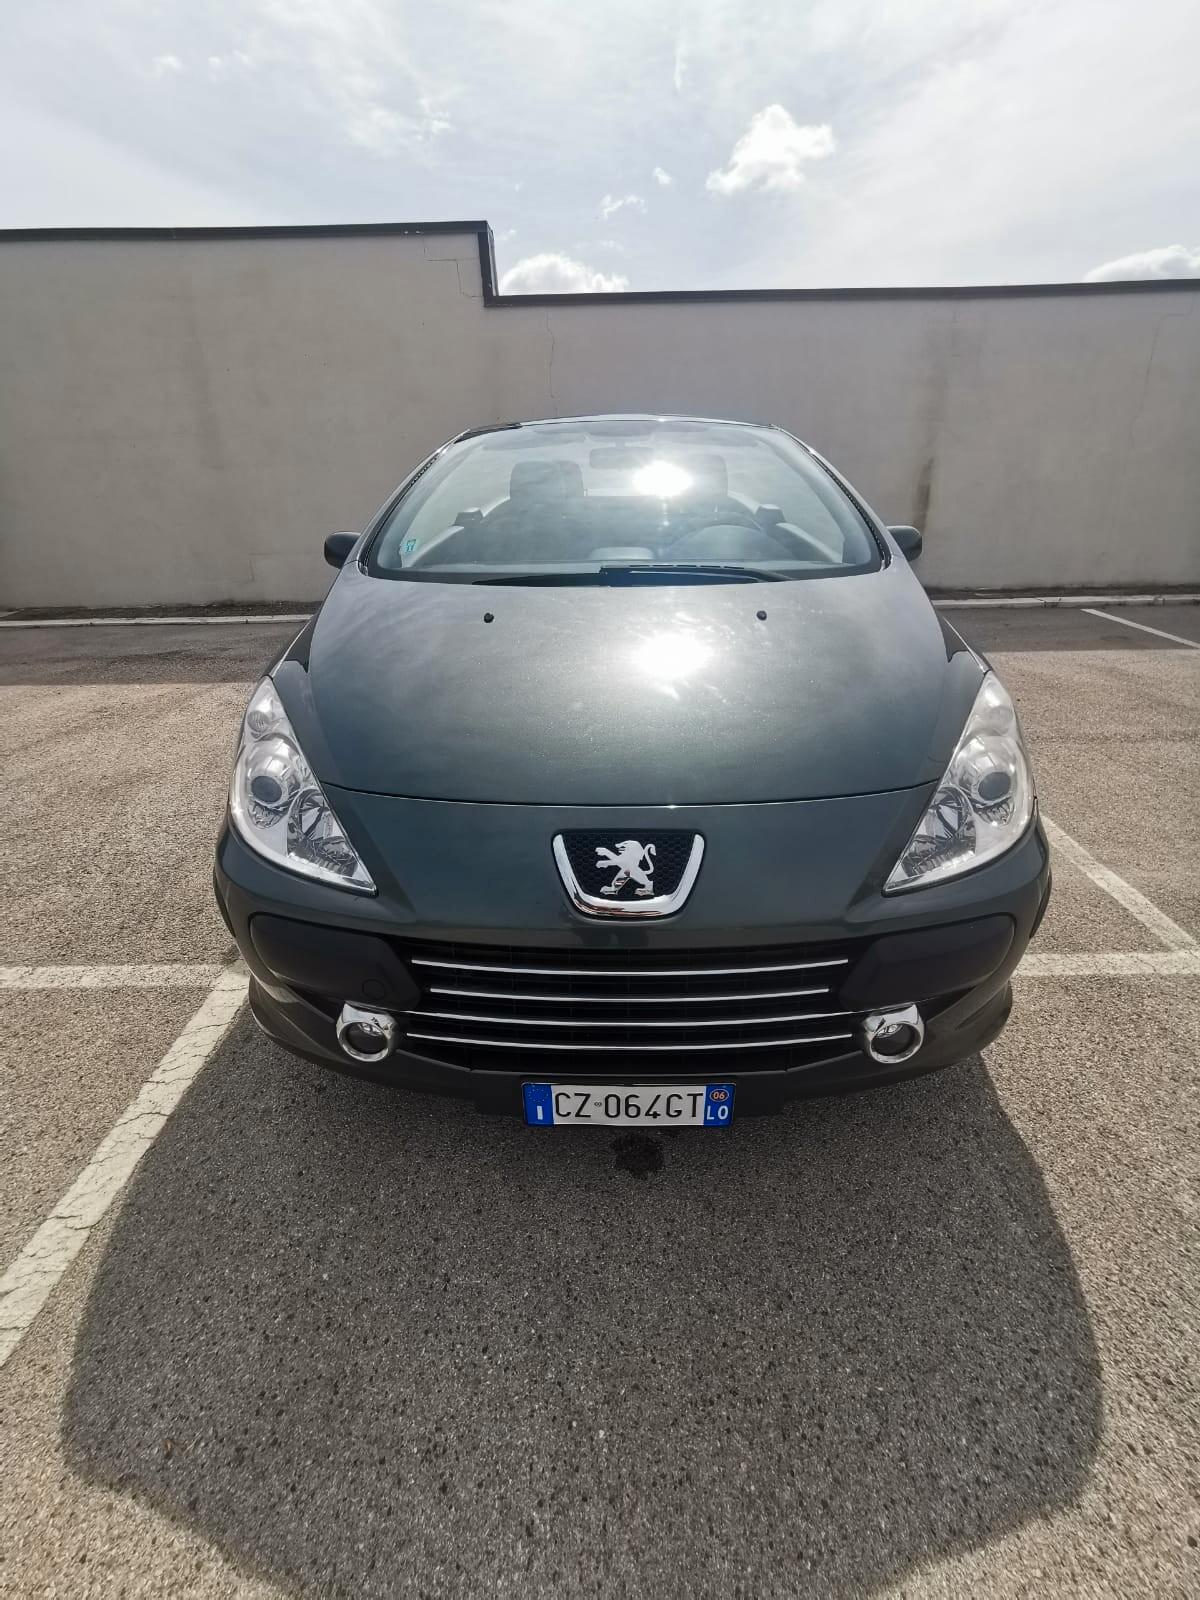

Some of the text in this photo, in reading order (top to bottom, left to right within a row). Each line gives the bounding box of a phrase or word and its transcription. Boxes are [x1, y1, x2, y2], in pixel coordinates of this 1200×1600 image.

[711, 1091, 726, 1100] 06
[536, 1105, 544, 1121] I
[554, 1092, 704, 1119] CZ 064GT
[706, 1105, 729, 1120] LO
